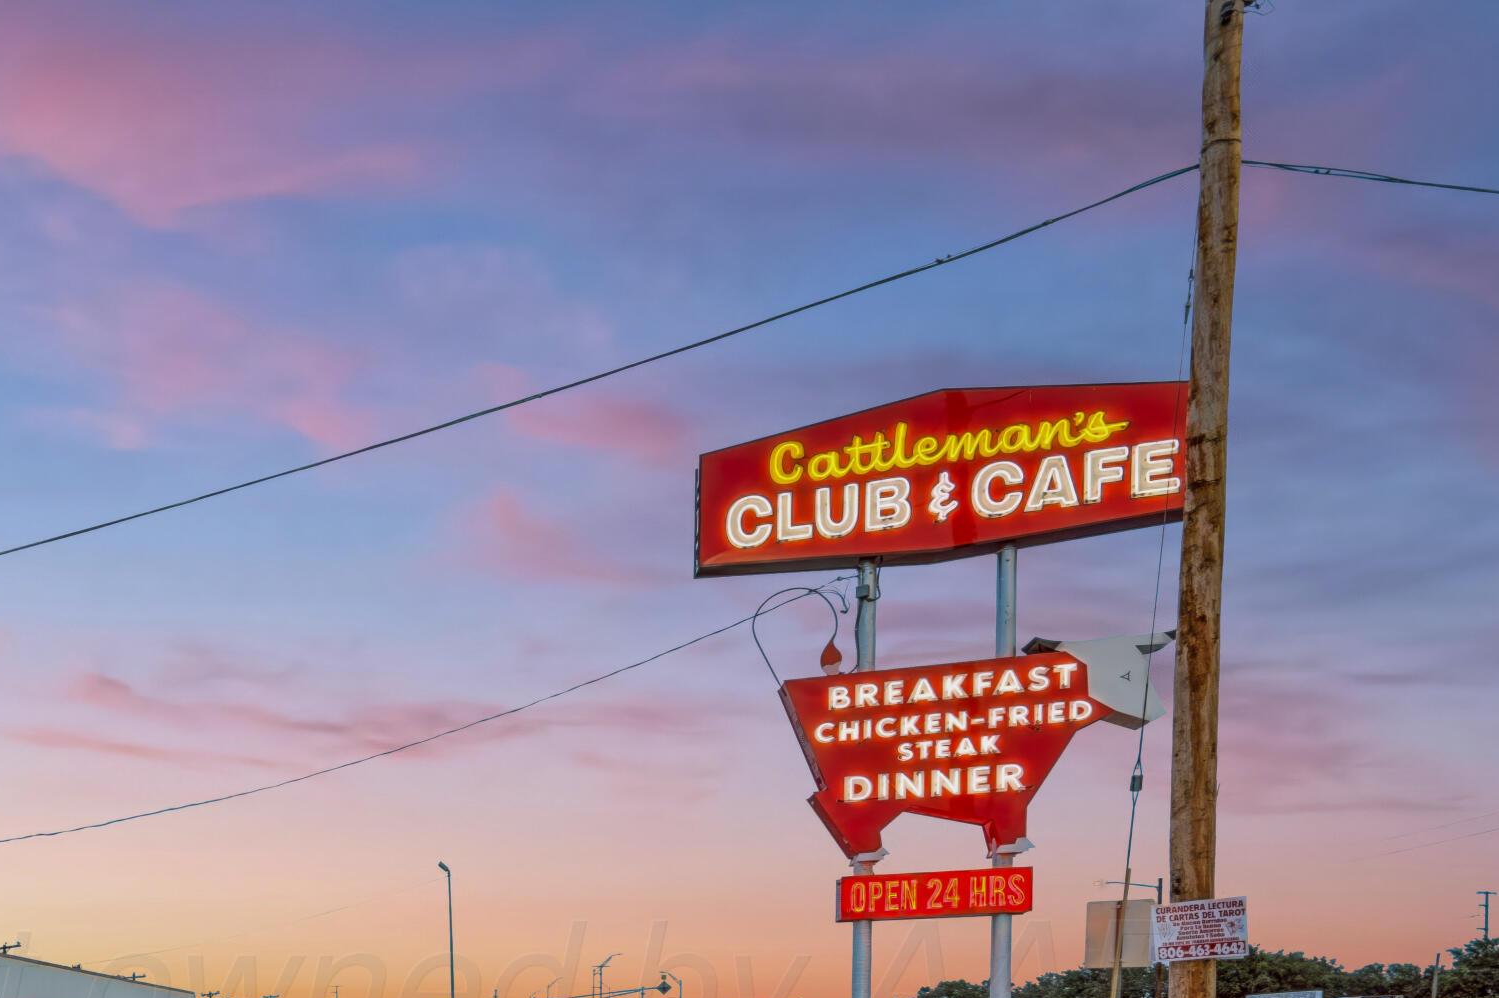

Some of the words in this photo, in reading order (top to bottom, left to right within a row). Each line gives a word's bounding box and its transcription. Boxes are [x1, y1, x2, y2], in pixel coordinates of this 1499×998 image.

[769, 410, 1130, 484] Cattleman's
[726, 476, 911, 549] CLUB
[928, 471, 959, 524] &
[971, 438, 1181, 518] CAFE
[828, 663, 1077, 710] BREAKFAST
[814, 700, 1093, 743] CHICKEN-FRIED
[897, 735, 1001, 761] STEAK
[843, 764, 1026, 802] DINNER
[850, 879, 917, 913] OPEN
[926, 878, 960, 910] 24
[969, 874, 1026, 908] HRS
[1156, 903, 1206, 915] CURANDERA
[1208, 900, 1244, 911] LECTURA
[1156, 915, 1166, 923] DE
[1169, 912, 1199, 922] CARTAS
[1202, 911, 1216, 919] DEL
[1218, 908, 1246, 917] TAROT
[1159, 942, 1245, 959] 806-463-4642
